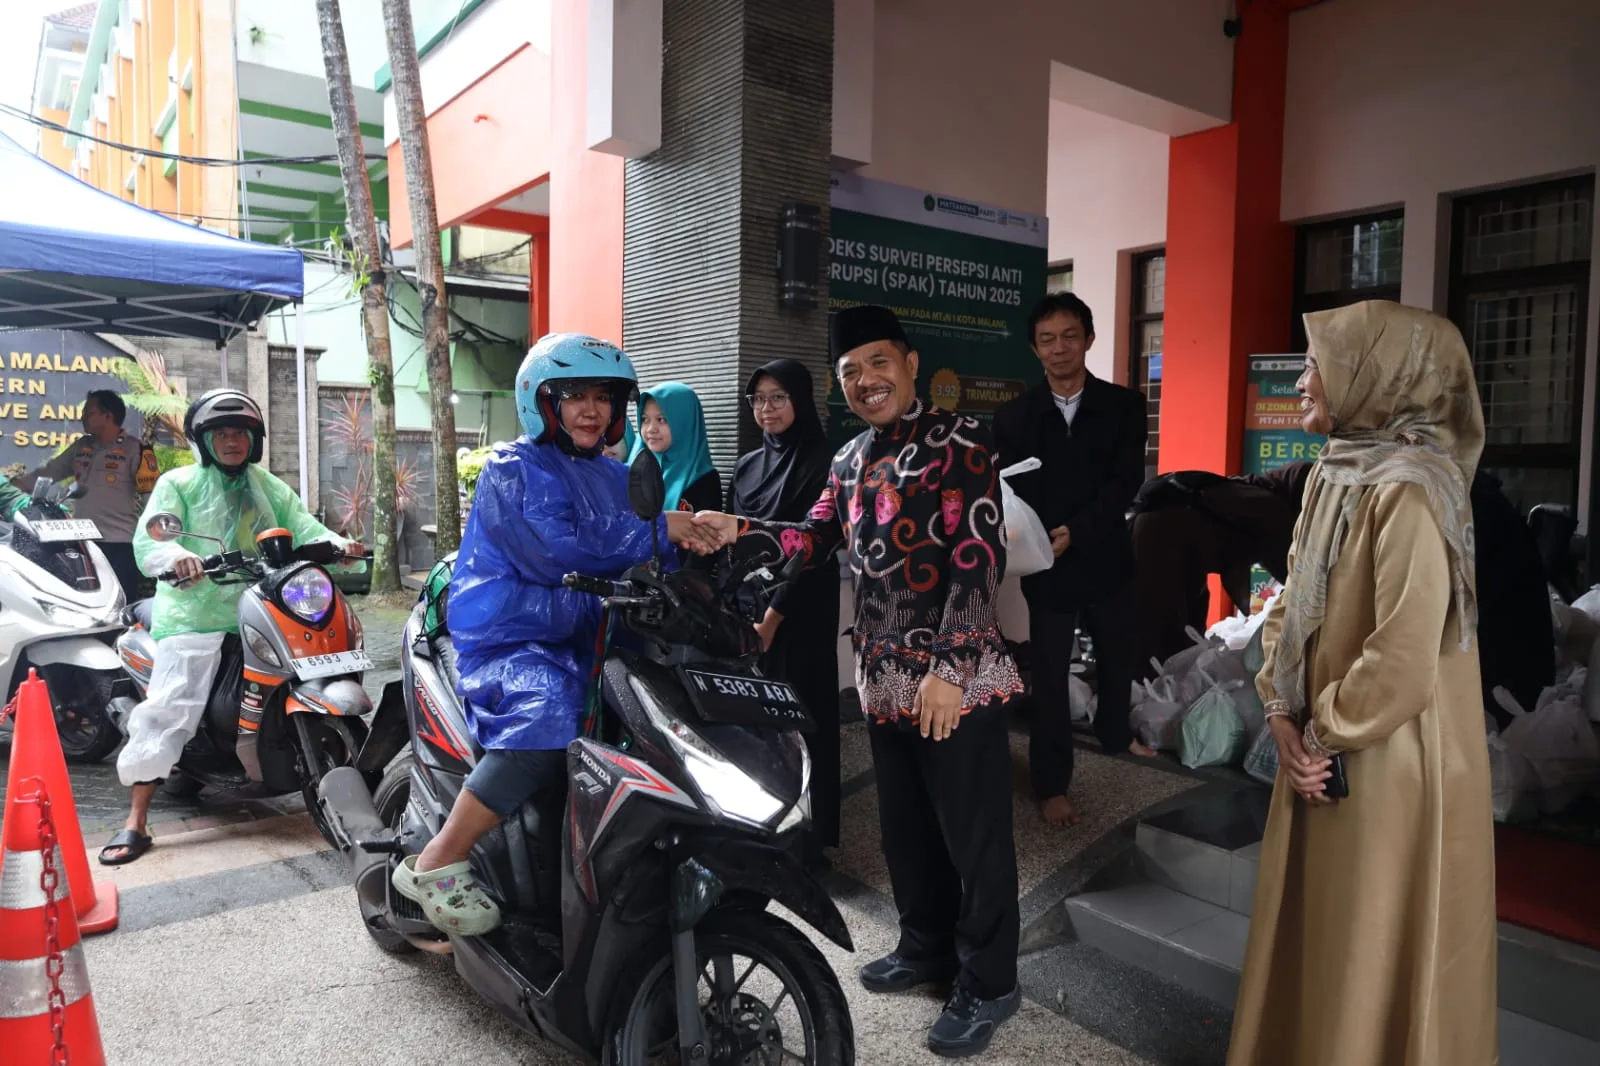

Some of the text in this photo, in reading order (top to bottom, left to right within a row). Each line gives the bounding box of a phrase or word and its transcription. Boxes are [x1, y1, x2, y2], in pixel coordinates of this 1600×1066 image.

[869, 244, 923, 269] SURVEI
[926, 254, 989, 280] PERSEPSI
[991, 266, 1022, 285] ANTI
[827, 262, 1021, 306] RUPSI (SPAK) TAHUN 2025
[910, 309, 931, 319] PADA
[957, 314, 976, 325] KOTA
[936, 384, 956, 397] 3,92
[966, 388, 1013, 401] TRIWULAN
[292, 660, 302, 669] N
[307, 653, 341, 667] 6593
[693, 674, 799, 703] N 5383 ABA
[580, 750, 611, 785] HONDA
